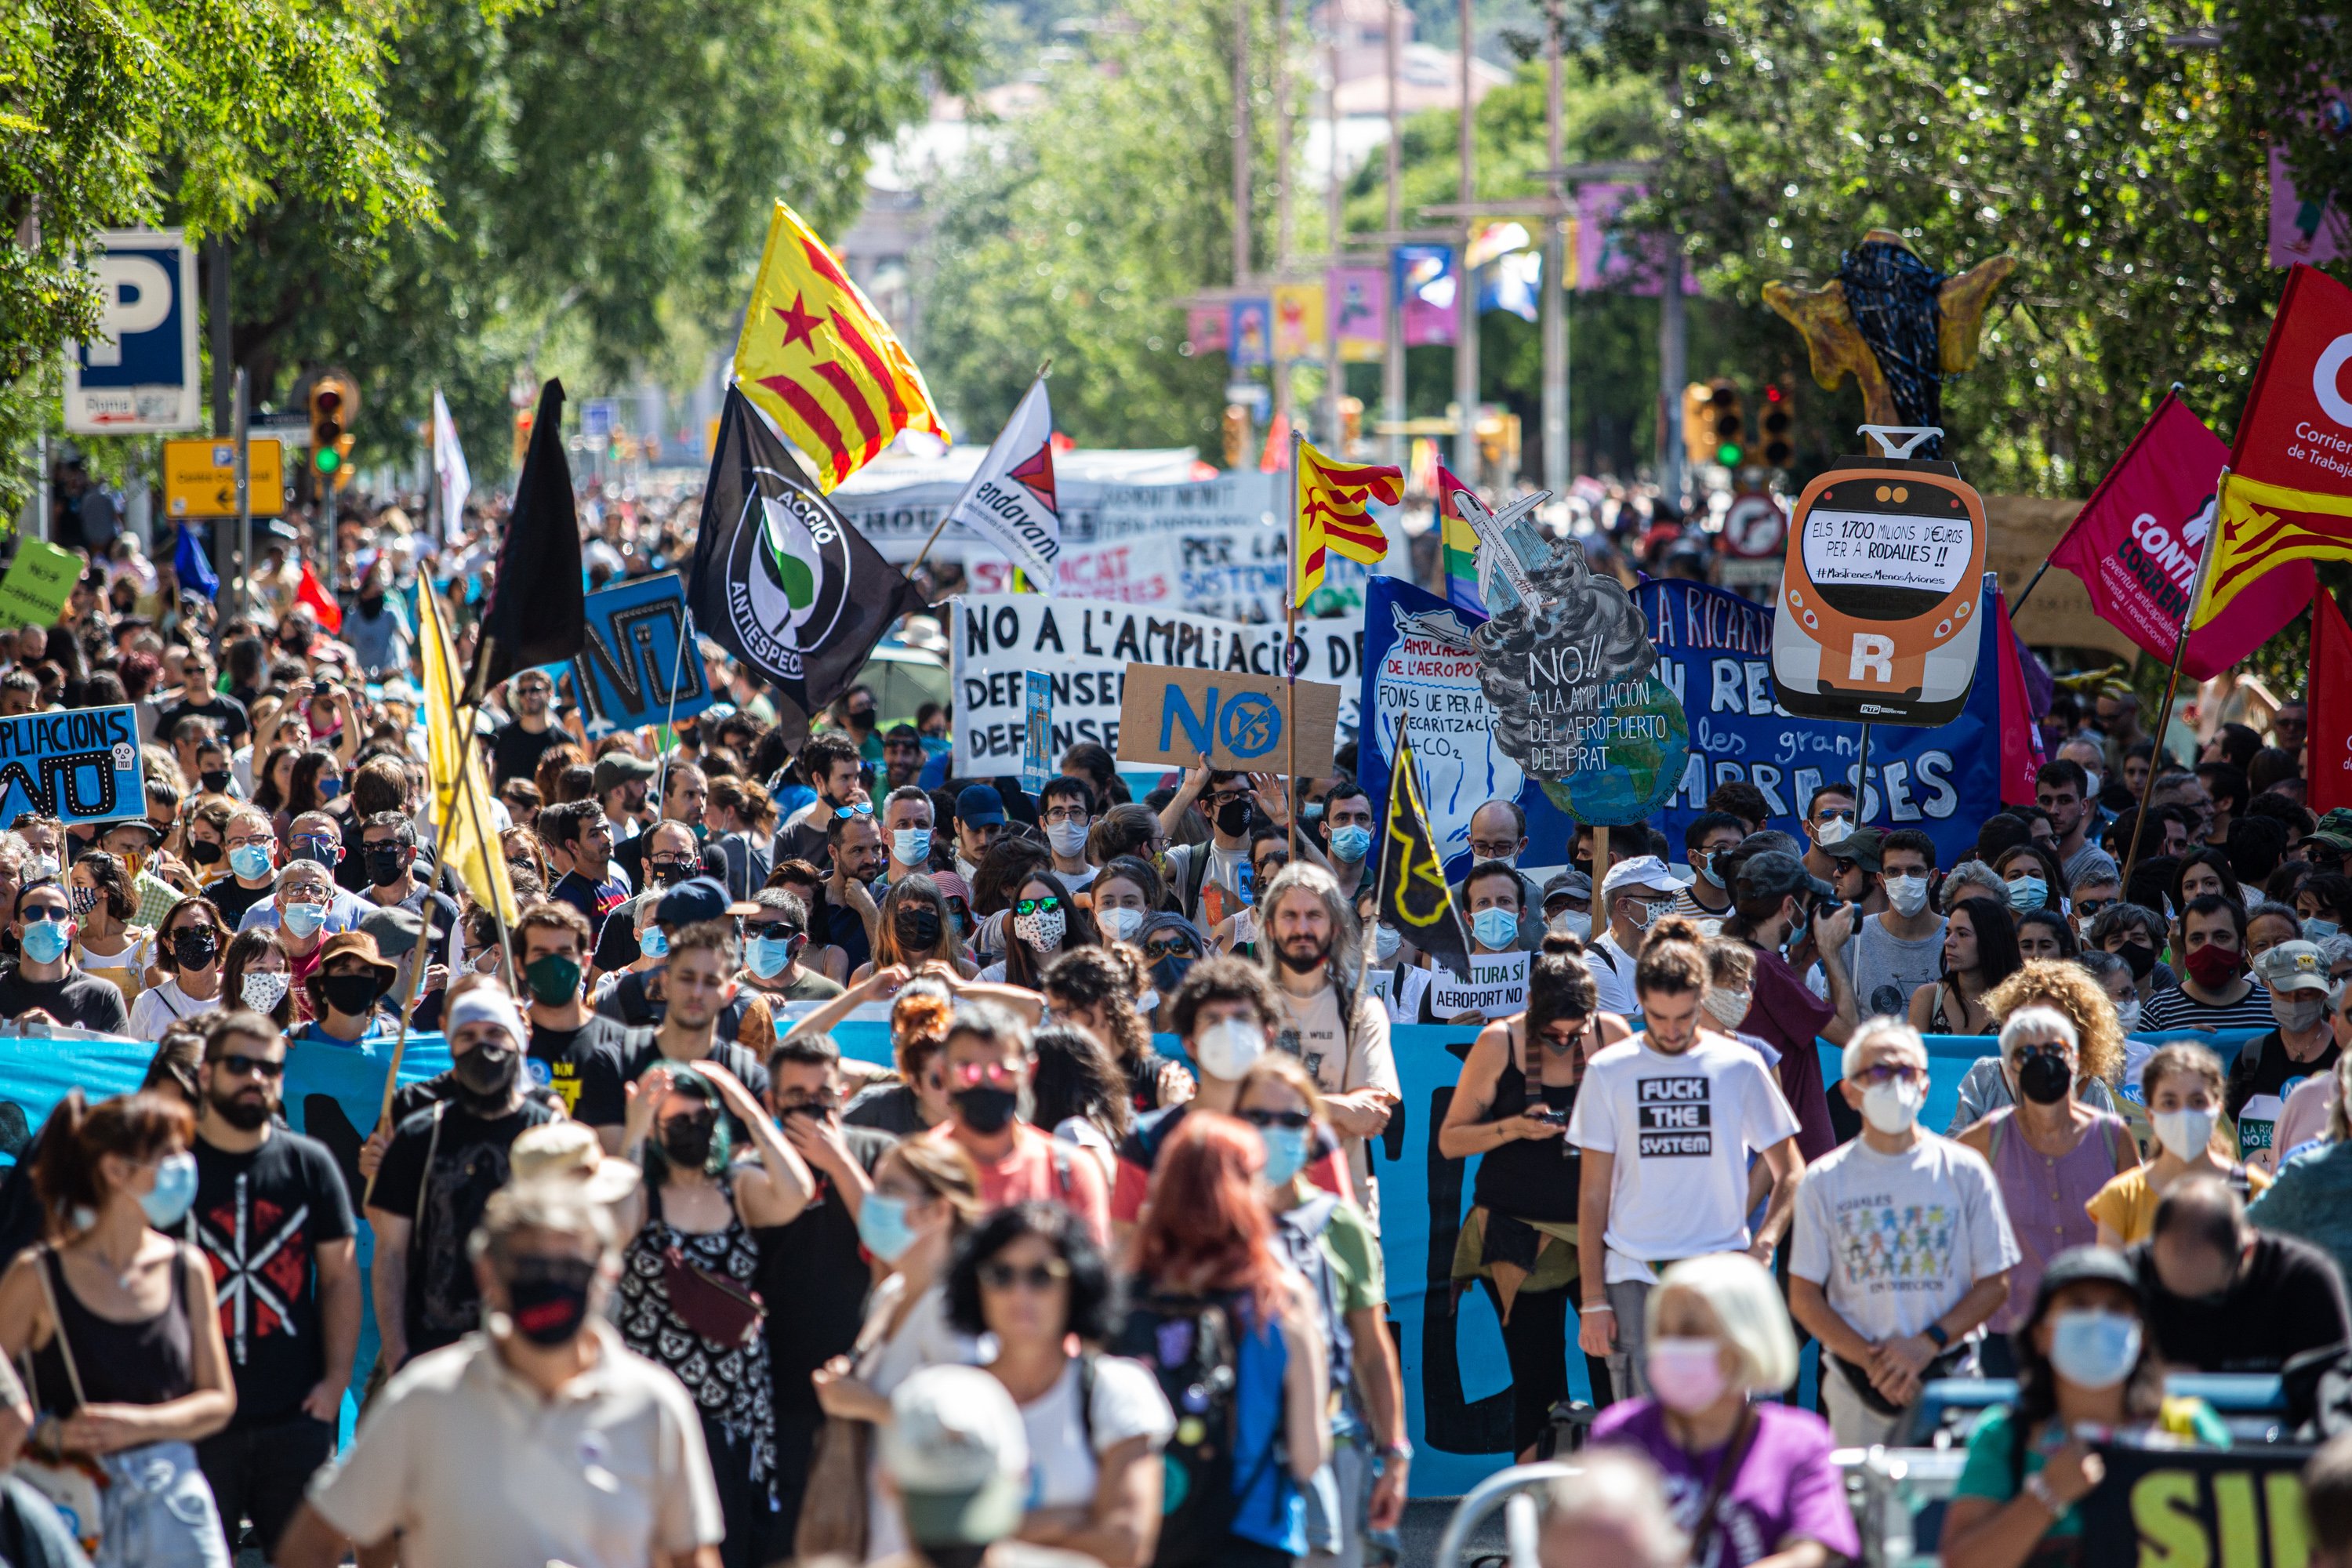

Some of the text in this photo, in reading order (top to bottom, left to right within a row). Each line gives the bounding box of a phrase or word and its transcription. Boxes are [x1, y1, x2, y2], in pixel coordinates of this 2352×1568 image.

[88, 255, 172, 366] P
[2288, 444, 2305, 459] de
[777, 490, 837, 544] ACCIÓ
[1813, 522, 1833, 538] ELS
[1842, 521, 1874, 539] 1.700
[1877, 524, 1915, 540] MILIONS
[1826, 541, 1847, 557] PER
[1853, 542, 1862, 557] A
[1868, 542, 1930, 563] RODALIES
[2100, 568, 2125, 601] eminista
[2102, 554, 2137, 592] joventut
[2118, 537, 2190, 626] CORREN
[731, 581, 804, 672] ANTIESPECI
[967, 604, 1019, 657] NO
[1034, 606, 1064, 652] A
[1687, 586, 1773, 655] RICARD
[1388, 660, 1404, 675] DE
[1849, 633, 1895, 683] R
[964, 671, 1127, 712] DEFNSE
[1379, 685, 1420, 708] FONS
[1426, 693, 1443, 713] UE
[1447, 695, 1472, 715] PER
[1475, 695, 1483, 714] A
[1529, 678, 1650, 715] A LA AMPLIACIÓN
[1711, 658, 1794, 718] RE
[1159, 684, 1282, 758] NO
[1861, 705, 1881, 713] PTP
[0, 711, 129, 758] PLIACIONS
[969, 719, 1120, 760] DEFNSE
[1530, 715, 1666, 742] DEL AEROPUERTO
[1698, 717, 1875, 764] les grans
[1532, 746, 1610, 771] DEL PRAT
[1567, 808, 1590, 823] STOP
[1627, 809, 1648, 822] SAVE
[1650, 797, 1665, 811] THE
[1664, 766, 1684, 798] PLANET
[1662, 750, 1958, 822] MPRESES
[1455, 960, 1524, 985] NTURA SÍ
[1436, 987, 1523, 1008] AEROPORT NO
[1642, 1079, 1703, 1100] FUCK
[1649, 1106, 1699, 1127] THE
[2244, 1125, 2256, 1135] LA
[1641, 1135, 1710, 1153] SYSTEM
[2242, 1135, 2260, 1146] NO
